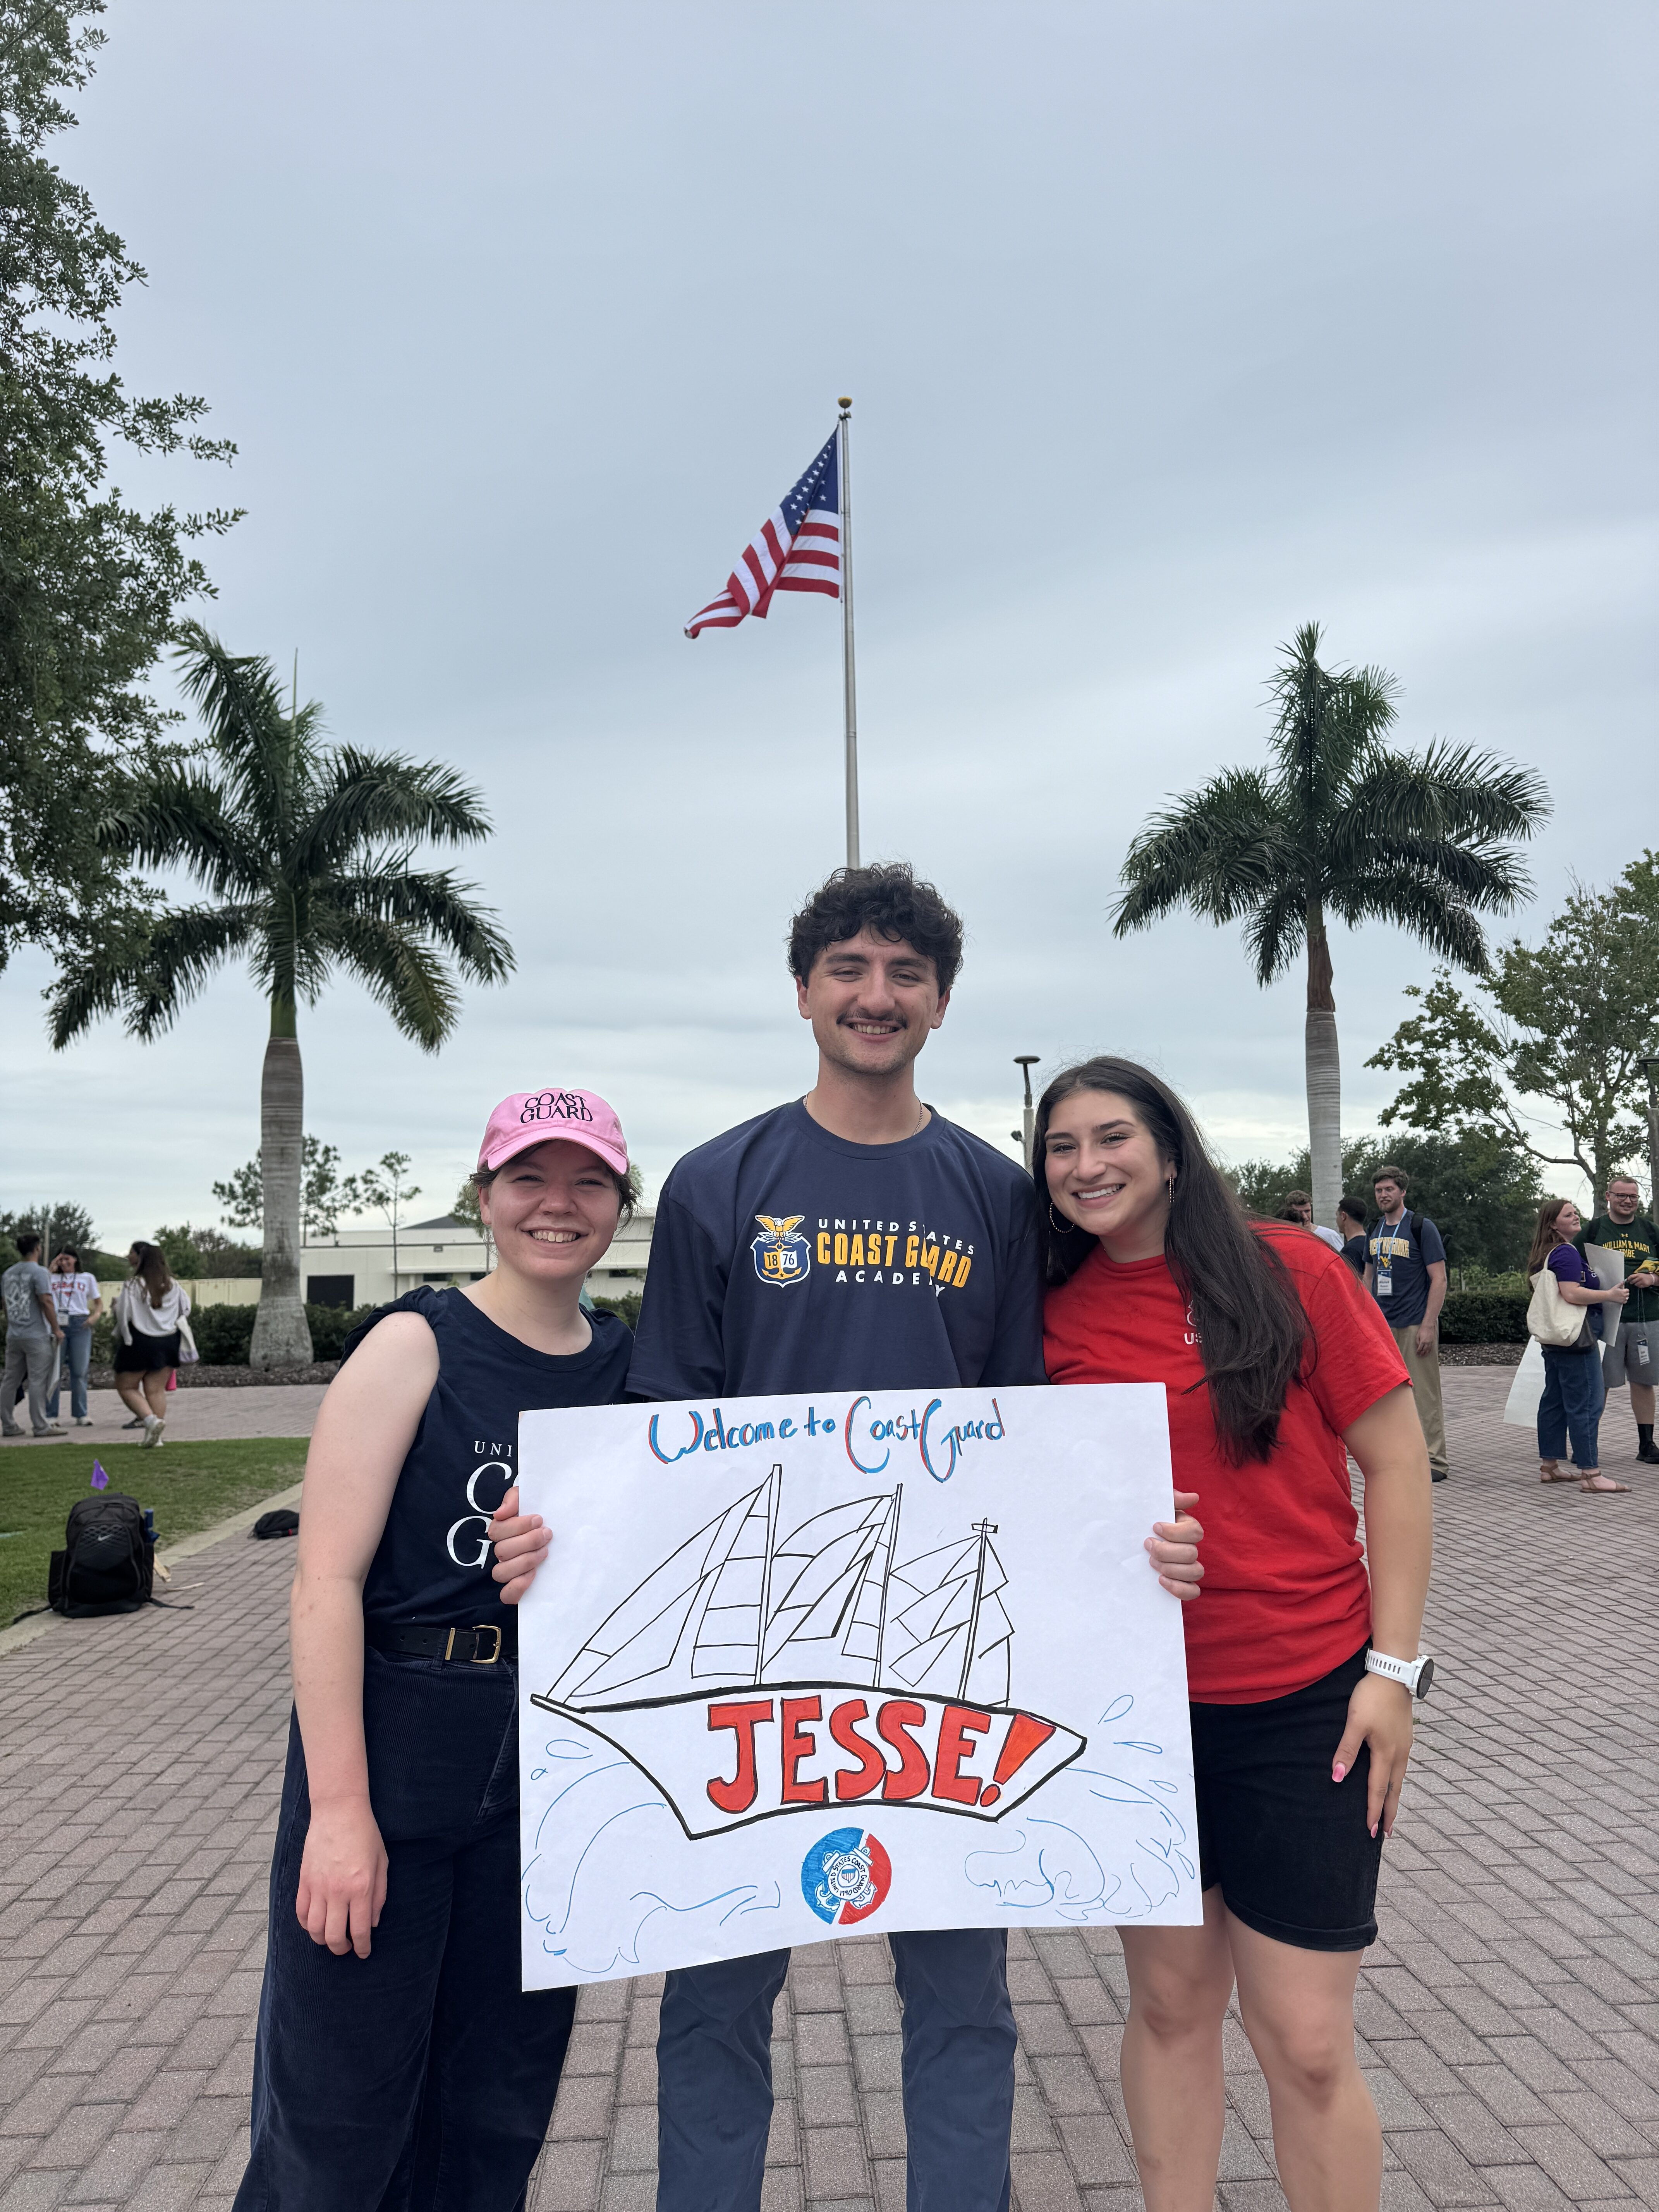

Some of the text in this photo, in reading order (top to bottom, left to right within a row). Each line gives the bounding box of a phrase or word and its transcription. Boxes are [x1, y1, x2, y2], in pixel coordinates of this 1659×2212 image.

[520, 1105, 593, 1123] GUARD
[525, 1092, 586, 1109] COAST
[818, 1218, 974, 1255] UNITED SATES
[1602, 1240, 1627, 1249] WILLIAM
[1633, 1241, 1650, 1254] MARY
[817, 1232, 972, 1288] COAST GUARD
[835, 1270, 946, 1297] ACADEY
[649, 1396, 1006, 1484] Welcome to Coast Guard
[707, 1694, 1056, 1814] JESSE!
[830, 1856, 867, 1893] UNITED STATES COAST GUARD
